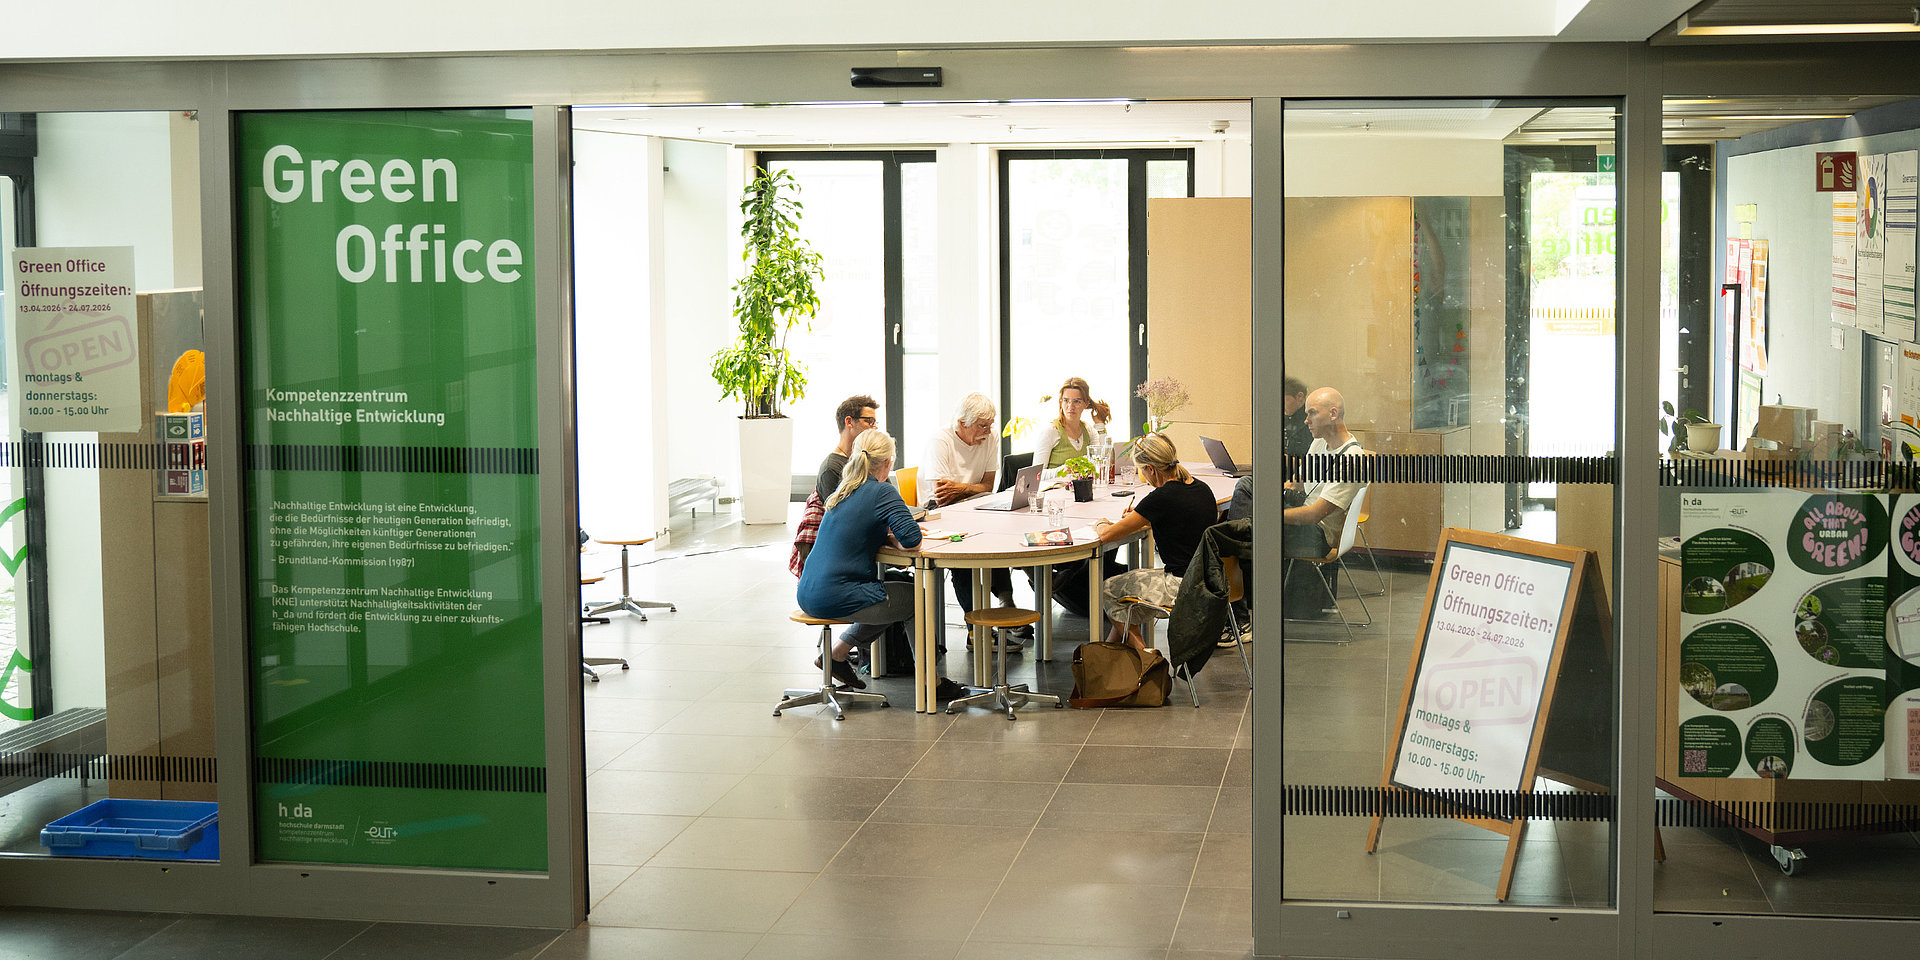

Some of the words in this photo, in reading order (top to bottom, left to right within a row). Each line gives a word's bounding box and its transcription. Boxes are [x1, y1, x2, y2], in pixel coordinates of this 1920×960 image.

[263, 144, 458, 203] Green
[336, 224, 523, 283] Office
[18, 260, 62, 273] Green
[66, 259, 106, 273] Office
[21, 281, 131, 299] Öffnungszeiten:
[19, 304, 62, 312] 13.04.2026
[68, 303, 111, 312] 24.07.2026
[40, 330, 122, 371] OPEN
[25, 372, 72, 384] montags
[75, 371, 83, 382] &
[25, 390, 97, 402] donnerstags:
[266, 388, 408, 405] Kompetenzzentrum
[28, 406, 54, 415] 10.00
[63, 406, 89, 416] 15.00
[91, 405, 109, 415] Uhr
[266, 408, 352, 426] Nachhaltige
[356, 409, 445, 426] Entwicklung
[329, 502, 383, 513] Entwicklung
[385, 503, 396, 512] ist
[398, 503, 417, 512] eine
[419, 503, 477, 514] Entwicklung,
[1803, 507, 1824, 530] ALL
[1825, 501, 1867, 525] ABOUT
[269, 514, 283, 522] die
[285, 514, 299, 522] die
[301, 513, 354, 524] Bedürfnisse
[356, 515, 371, 524] der
[373, 515, 412, 526] heutigen
[414, 516, 463, 526] Generation
[465, 516, 512, 528] befriedigt,
[1822, 518, 1847, 529] THAT
[270, 526, 292, 535] ohne
[294, 526, 307, 535] die
[309, 526, 371, 537] Möglichkeiten
[373, 527, 414, 538] künftiger
[416, 527, 476, 538] Generationen
[1819, 530, 1848, 539] URBAN
[270, 540, 281, 548] zu
[283, 538, 330, 549] gefährden,
[332, 540, 349, 549] ihre
[351, 541, 386, 550] eigenen
[389, 539, 443, 550] Bedürfnisse
[445, 542, 455, 550] zu
[1802, 527, 1868, 567] GREEN!
[278, 555, 387, 567] Brundtland-Kommission
[388, 557, 415, 568] (1987)
[1450, 564, 1491, 587] Green
[1494, 573, 1535, 596] Office
[272, 585, 289, 594] Das
[291, 585, 378, 597] Kompetenzzentrum
[381, 587, 435, 598] Nachhaltige
[437, 588, 492, 599] Entwicklung
[272, 597, 298, 607] (KNE)
[300, 597, 348, 607] unterstützt
[350, 599, 465, 611] Nachhaltigkeitsaktivitäten
[467, 602, 482, 610] der
[272, 610, 295, 620] h_da
[297, 610, 314, 619] und
[315, 610, 347, 620] fördert
[349, 611, 363, 620] die
[365, 611, 420, 623] Entwicklung
[422, 614, 433, 622] zu
[435, 613, 458, 622] einer
[460, 613, 504, 623] zukunfts-
[1443, 590, 1553, 634] Öffnungszeiten:
[272, 622, 306, 633] fähigen
[307, 622, 361, 633] Hochschule.
[1436, 620, 1476, 637] 13.04.2026
[1482, 631, 1525, 648] 24.07.2026
[1435, 676, 1523, 711] OPEN
[1415, 708, 1461, 732] montags
[1462, 719, 1471, 733] &
[1410, 731, 1478, 761] donnerstags:
[1407, 751, 1431, 768] 10.00
[1440, 762, 1464, 778] 15.00
[1466, 768, 1486, 784] Uhr
[278, 802, 313, 819] h_da
[314, 822, 345, 830] darmstadt
